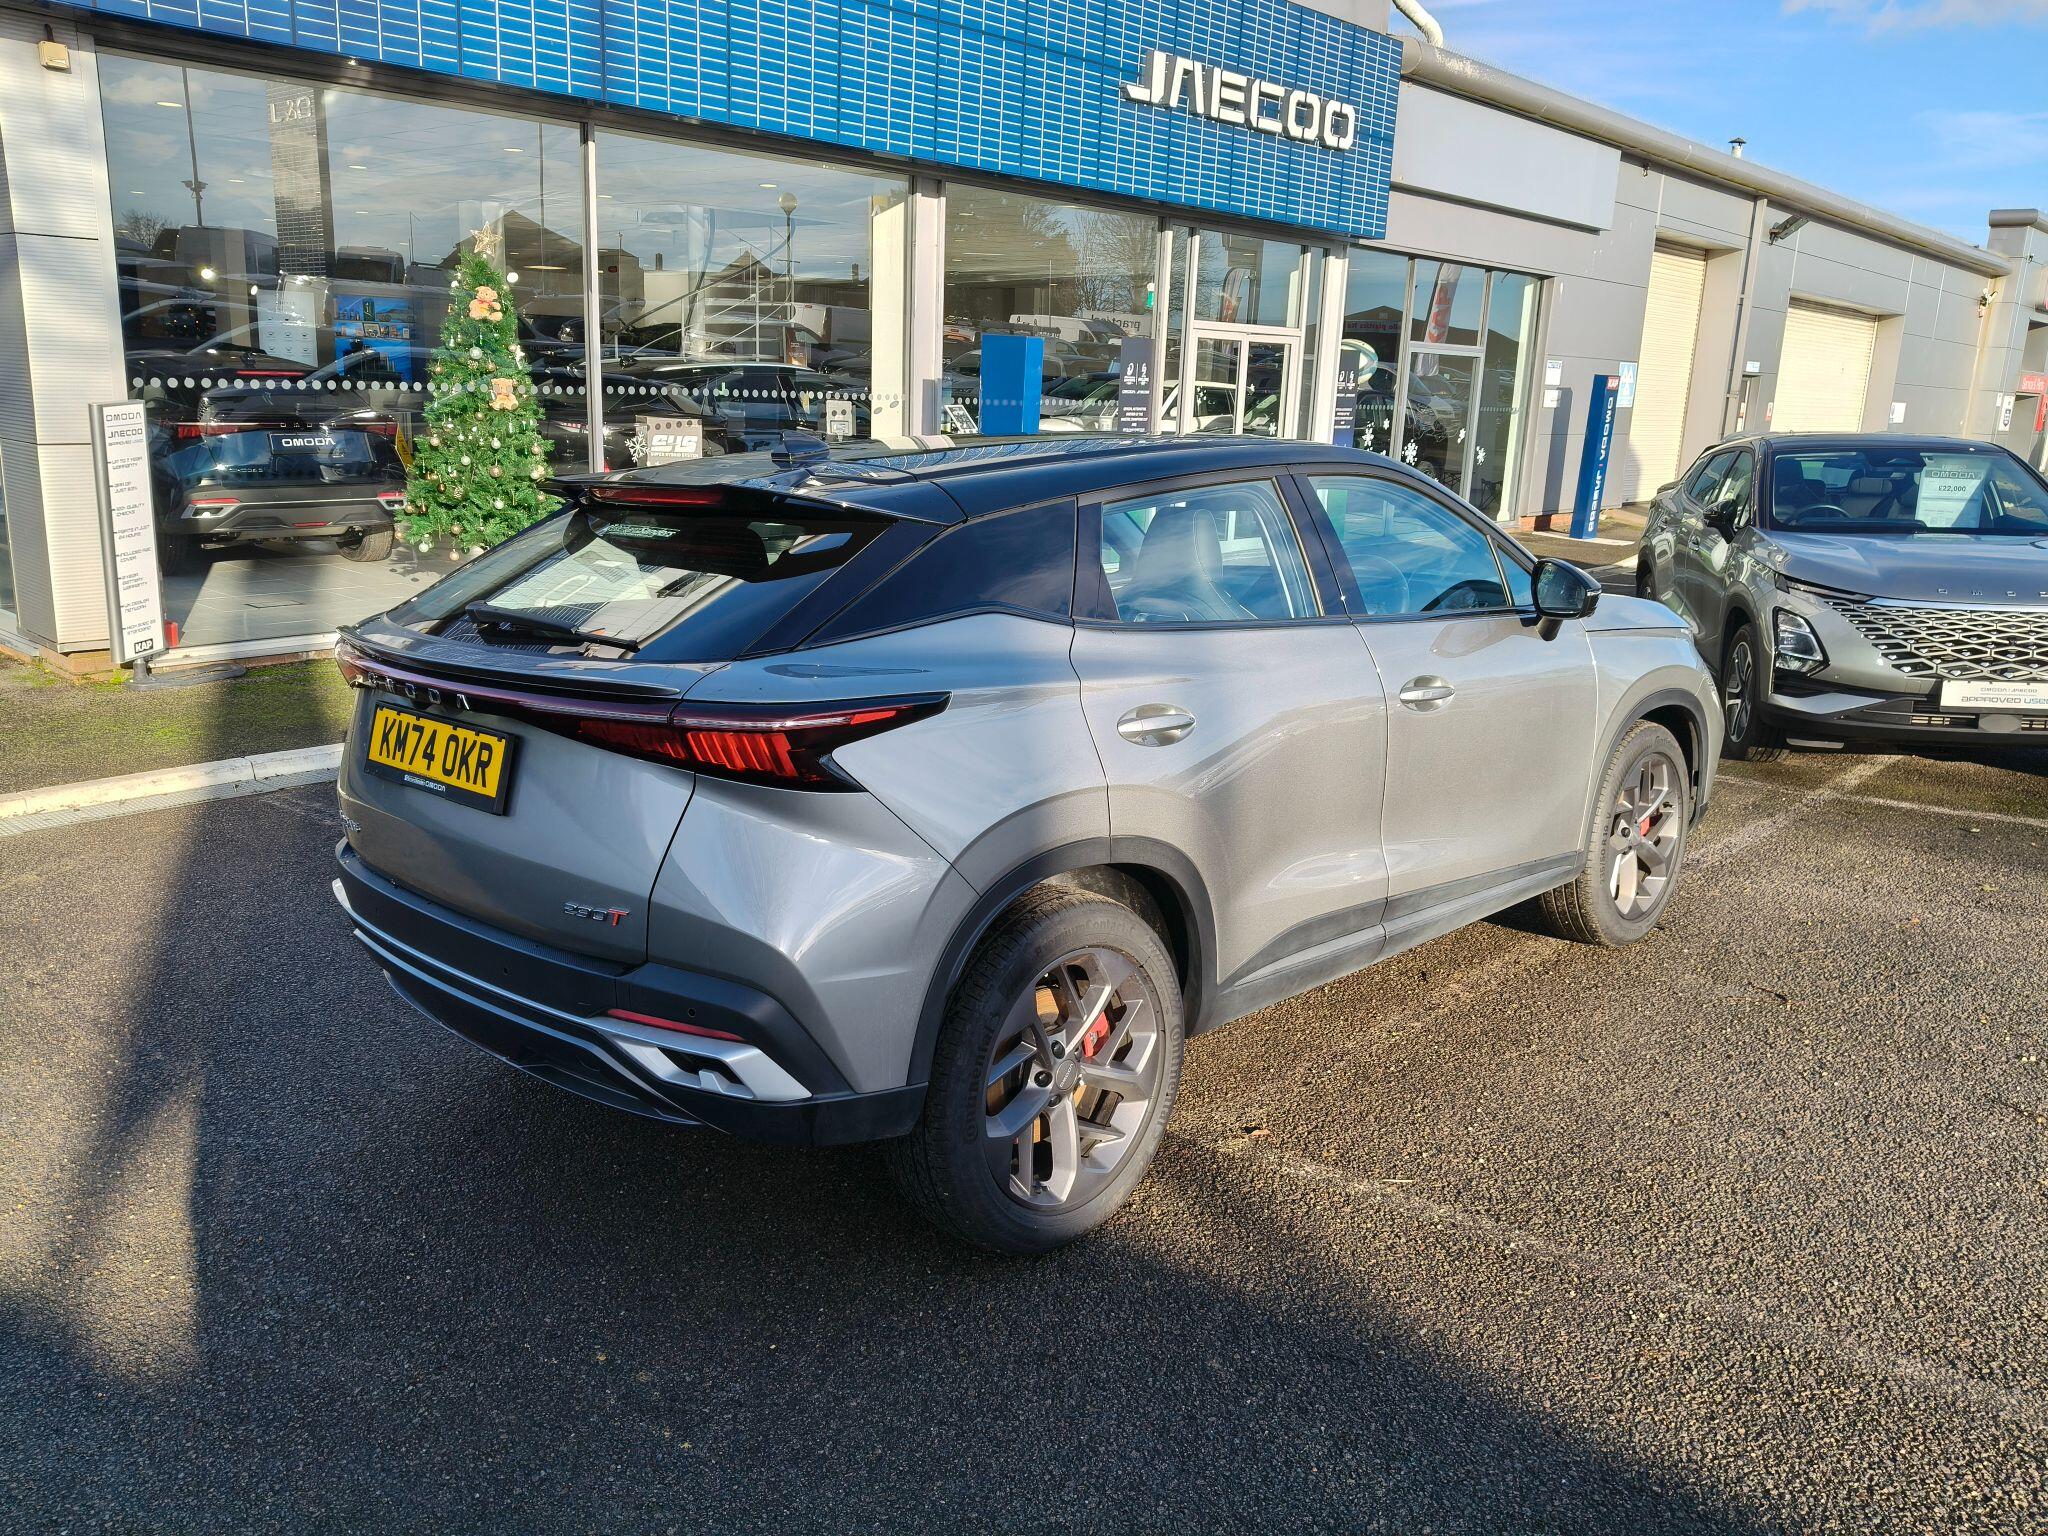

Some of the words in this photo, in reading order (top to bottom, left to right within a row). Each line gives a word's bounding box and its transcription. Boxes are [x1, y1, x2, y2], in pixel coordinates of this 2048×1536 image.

[1119, 49, 1356, 150] JAECOO
[105, 412, 142, 422] OMODA
[107, 428, 143, 439] JAECOO
[1599, 396, 1614, 461] OMODA
[281, 437, 336, 447] OMODA
[1931, 471, 1976, 479] OMODA
[134, 639, 153, 654] KAP
[379, 716, 438, 772] KM74
[441, 734, 493, 789] OKR
